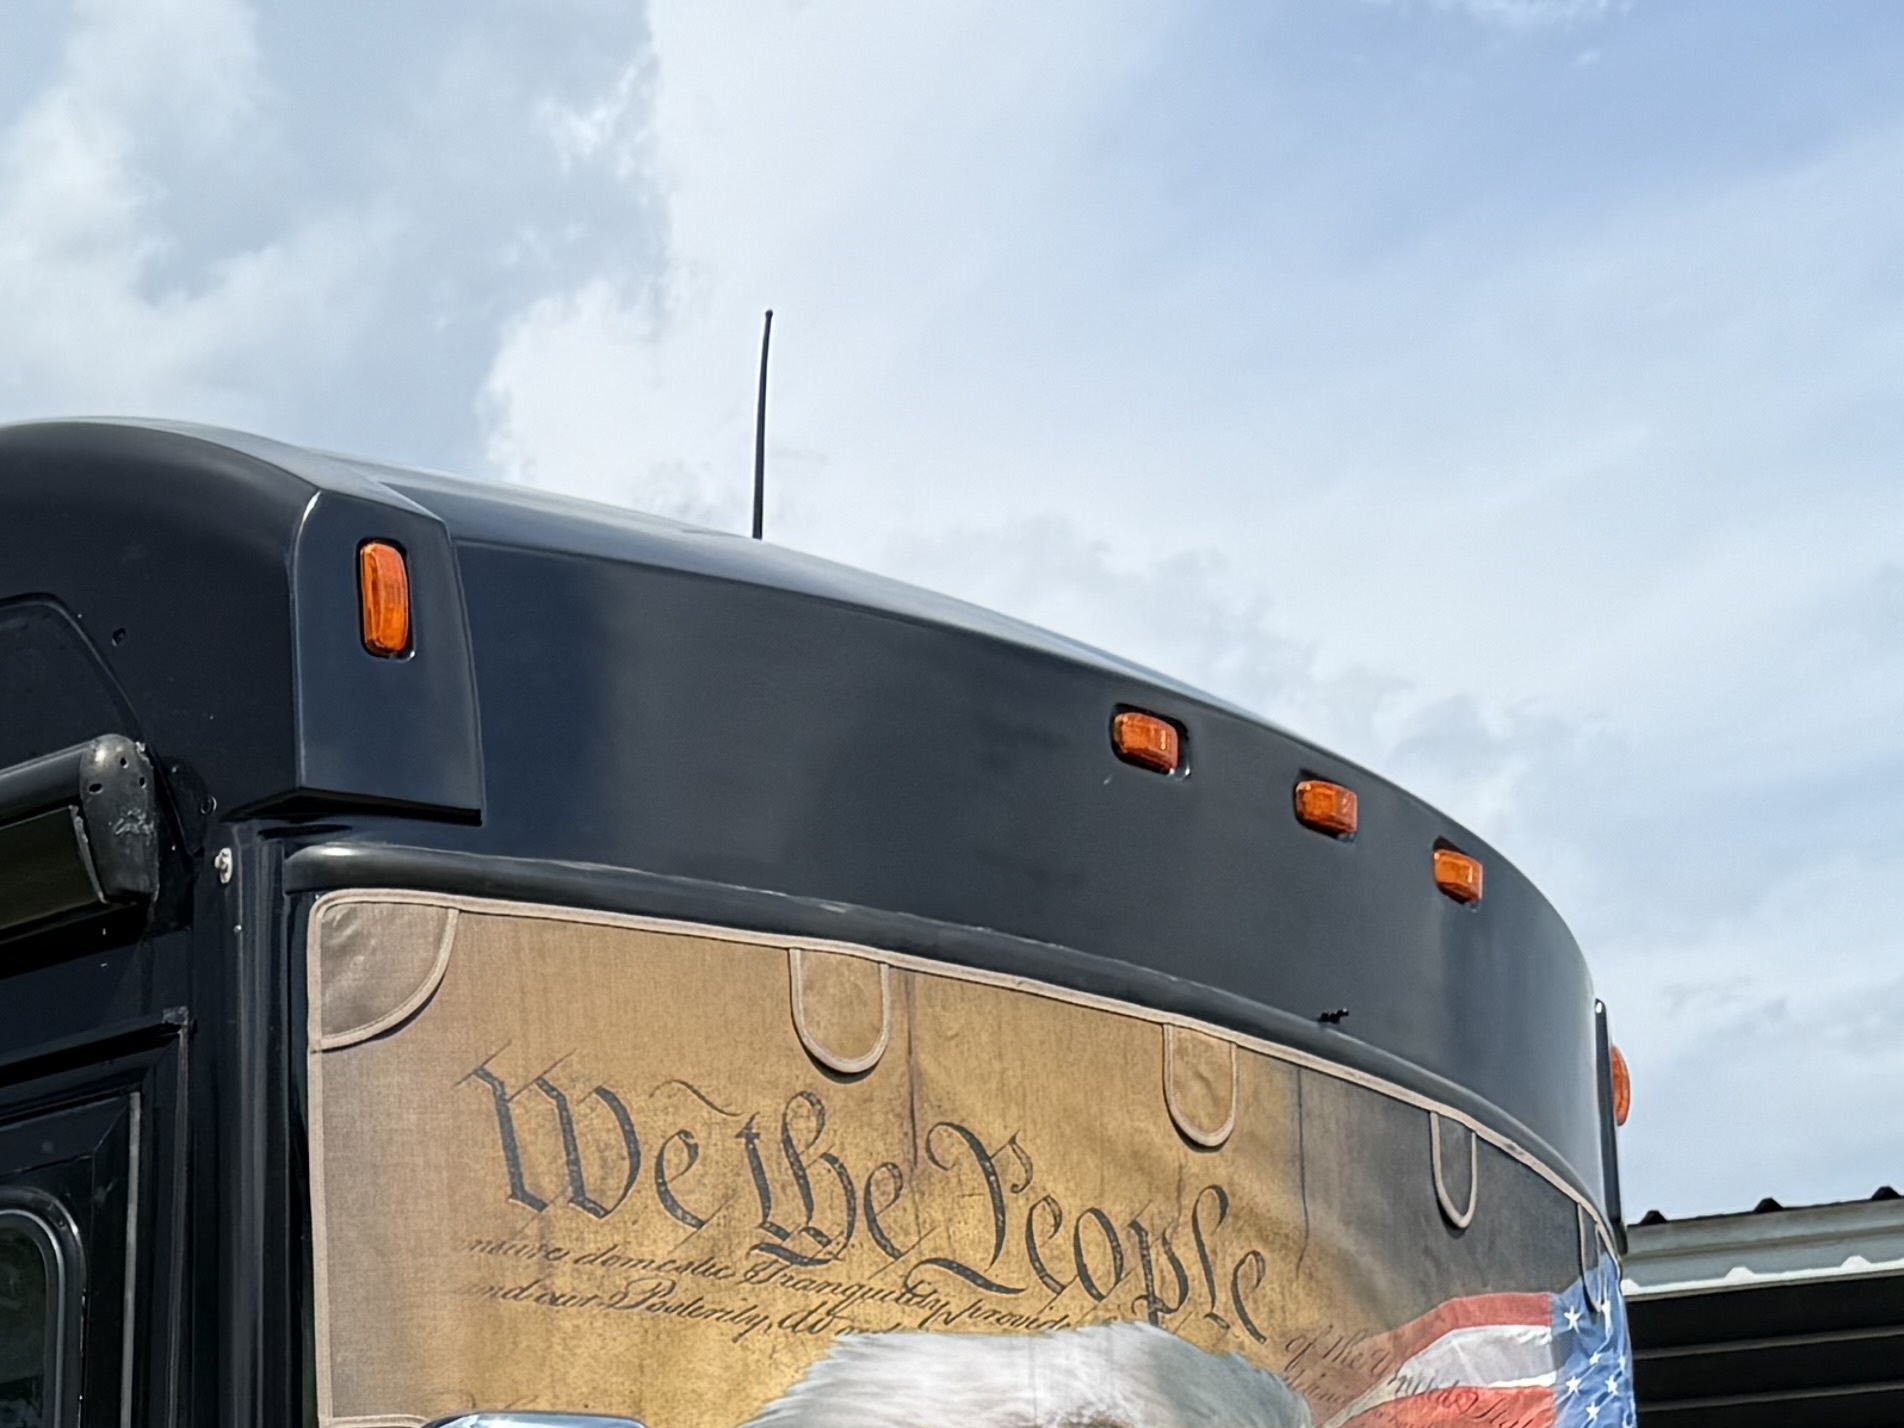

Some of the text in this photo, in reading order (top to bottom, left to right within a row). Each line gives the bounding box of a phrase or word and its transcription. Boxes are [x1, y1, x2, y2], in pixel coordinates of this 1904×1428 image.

[456, 1040, 1268, 1344] We the People
